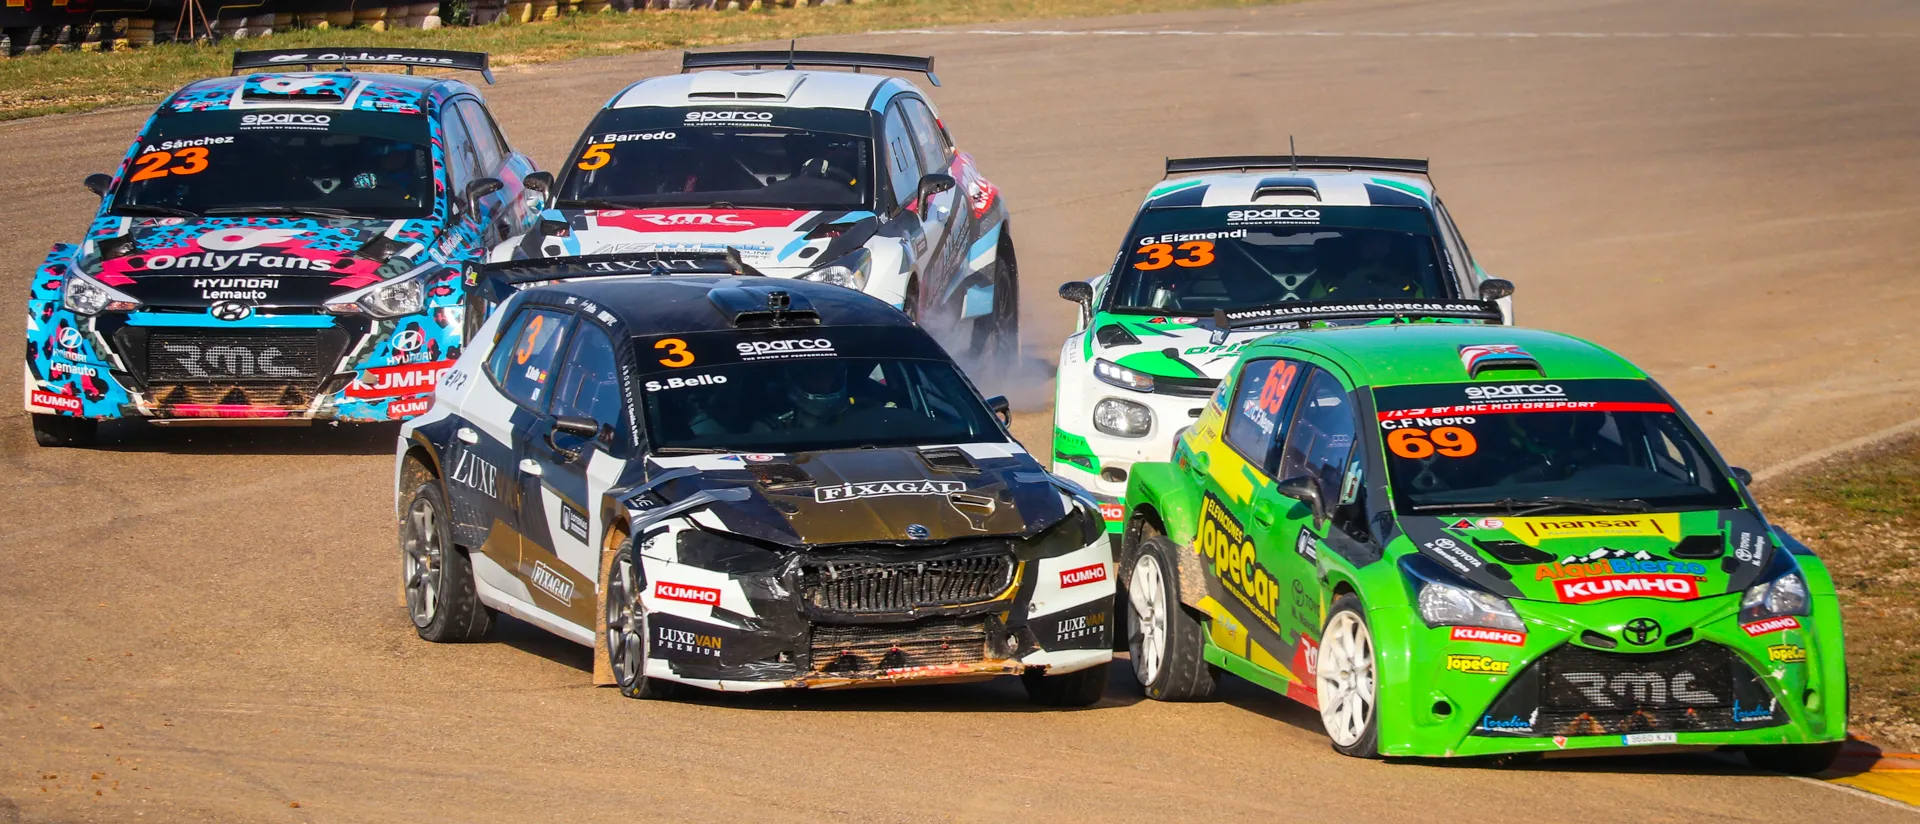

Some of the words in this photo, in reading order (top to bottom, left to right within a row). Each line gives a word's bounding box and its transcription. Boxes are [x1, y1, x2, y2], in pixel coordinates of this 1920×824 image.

[317, 53, 453, 64] OnlyFans
[242, 113, 330, 127] sparco
[684, 111, 773, 122] sparco
[143, 136, 235, 154] A.Sánchez
[588, 135, 598, 145] I.
[603, 131, 676, 144] Barredo
[130, 147, 209, 183] 23
[577, 143, 616, 171] 5
[1226, 208, 1320, 222] sparco
[1139, 229, 1248, 246] G.Eizmendi
[146, 252, 332, 271] OnlyFans
[1133, 241, 1215, 271] 33
[193, 278, 280, 289] HYUNDAI
[202, 289, 267, 300] Lemauto
[1226, 302, 1481, 320] WWW.ELEVACIONESJOPECAR.COM
[517, 314, 544, 365] 3
[736, 338, 834, 356] sparco
[386, 351, 432, 366] HYUNDAI
[653, 337, 696, 368] 3
[50, 359, 96, 377] Lemauto
[645, 374, 728, 392] S.Bello
[1260, 360, 1297, 415] 69
[1464, 384, 1565, 400] sparco
[33, 393, 80, 409] KUMHO
[1431, 405, 1451, 414] BY
[1455, 404, 1488, 412] RMC
[1491, 401, 1598, 411] MOTORSPORT
[1387, 426, 1478, 459] 69
[450, 449, 498, 499] LUXE
[1207, 500, 1244, 545] ELEVACIONES
[1535, 518, 1643, 530] nansar
[1193, 495, 1280, 618] JopeCar
[1451, 545, 1482, 568] TOYOTA
[1062, 567, 1105, 584] KUMHO
[1535, 557, 1706, 581] AlquiBierzo
[657, 585, 717, 602] KUMHO
[1563, 578, 1691, 598] KUMHO
[1057, 625, 1104, 642] PREMIUM
[1454, 628, 1522, 643] KUMHO
[1746, 618, 1798, 635] KUMHO
[658, 639, 721, 657] PREMIUM
[1446, 654, 1510, 672] JopeCar
